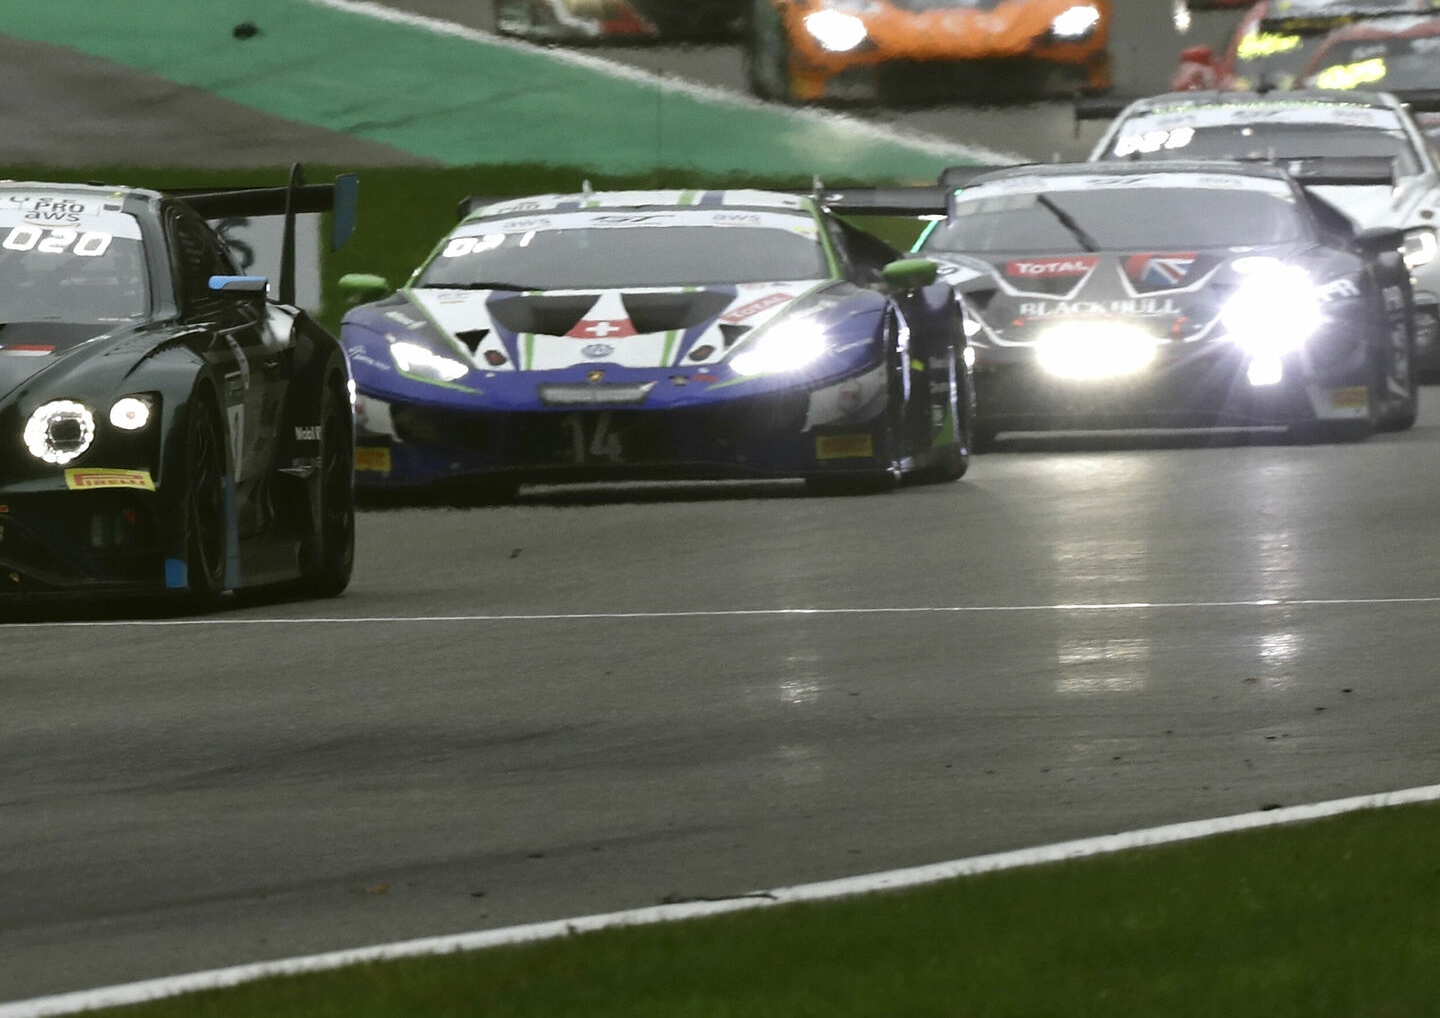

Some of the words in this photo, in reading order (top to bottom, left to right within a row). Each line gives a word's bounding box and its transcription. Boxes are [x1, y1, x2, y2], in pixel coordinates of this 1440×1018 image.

[34, 201, 86, 214] PRO
[24, 210, 81, 223] aws
[2, 226, 113, 257] 020
[1015, 260, 1091, 275] TOTAL
[1019, 301, 1107, 316] BLACK
